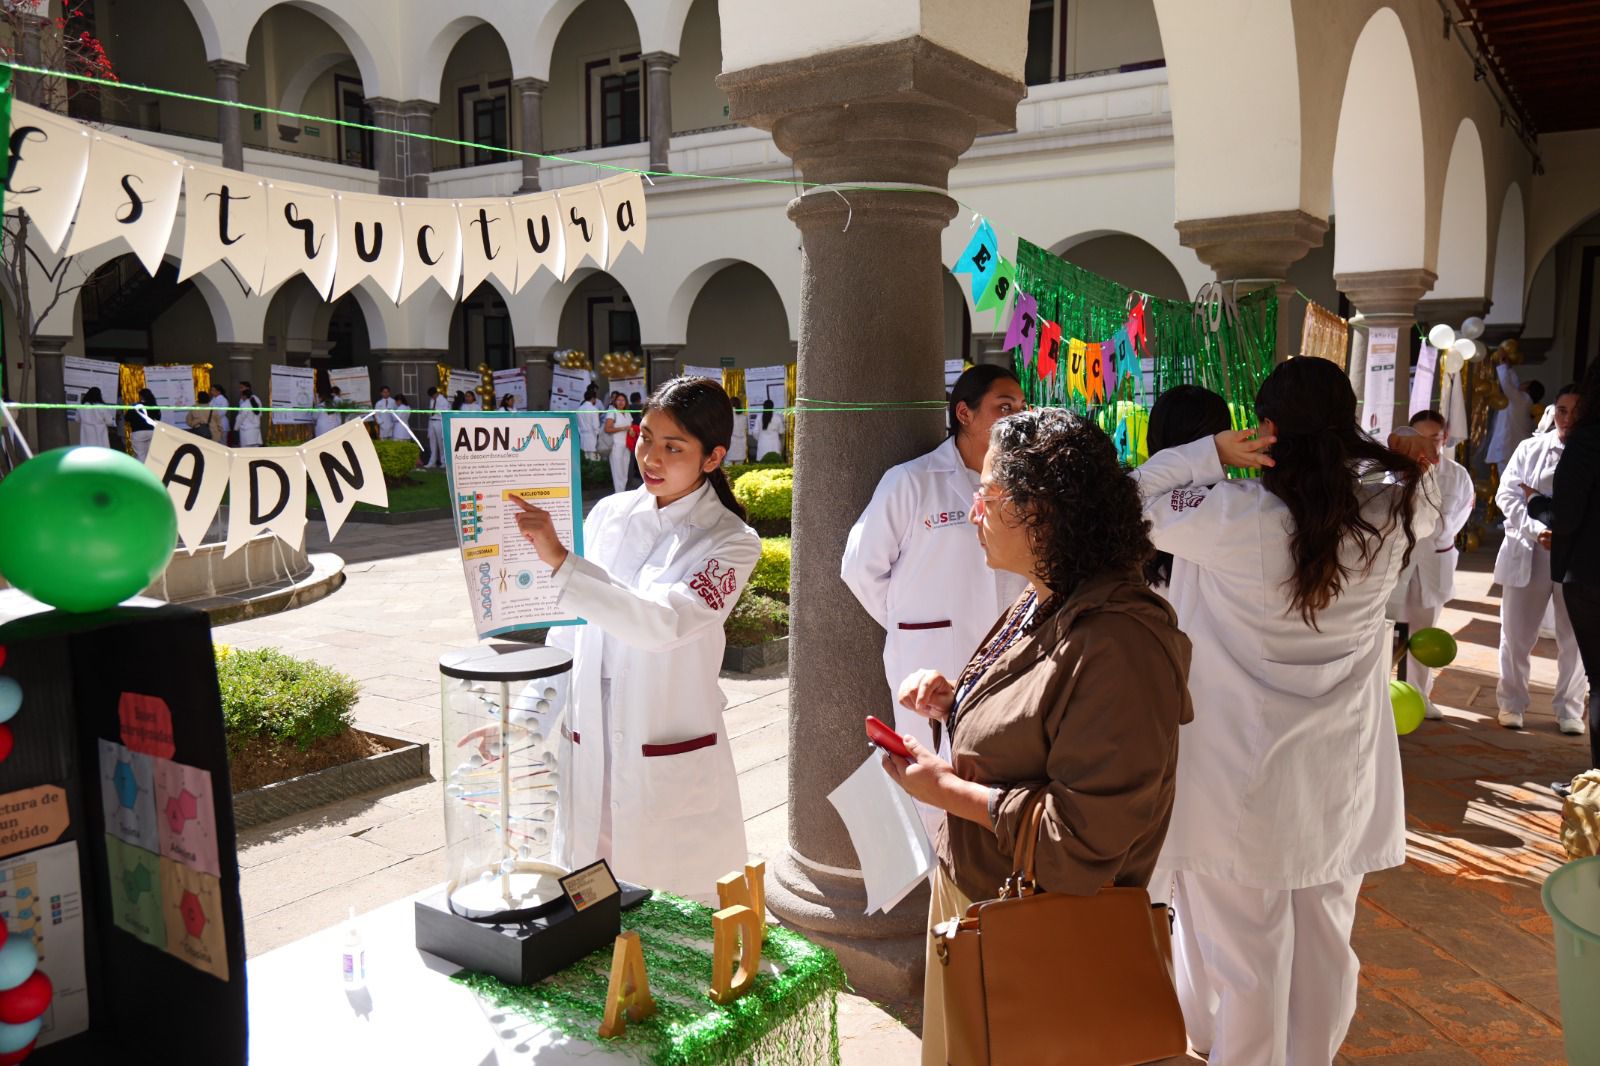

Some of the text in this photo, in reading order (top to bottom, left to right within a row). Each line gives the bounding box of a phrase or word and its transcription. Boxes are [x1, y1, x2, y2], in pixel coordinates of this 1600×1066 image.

[5, 126, 636, 266] Estructura
[455, 427, 510, 452] ADN
[163, 441, 364, 525] ADN
[931, 510, 966, 525] USEP
[690, 579, 719, 611] USEP
[41, 793, 59, 805] de
